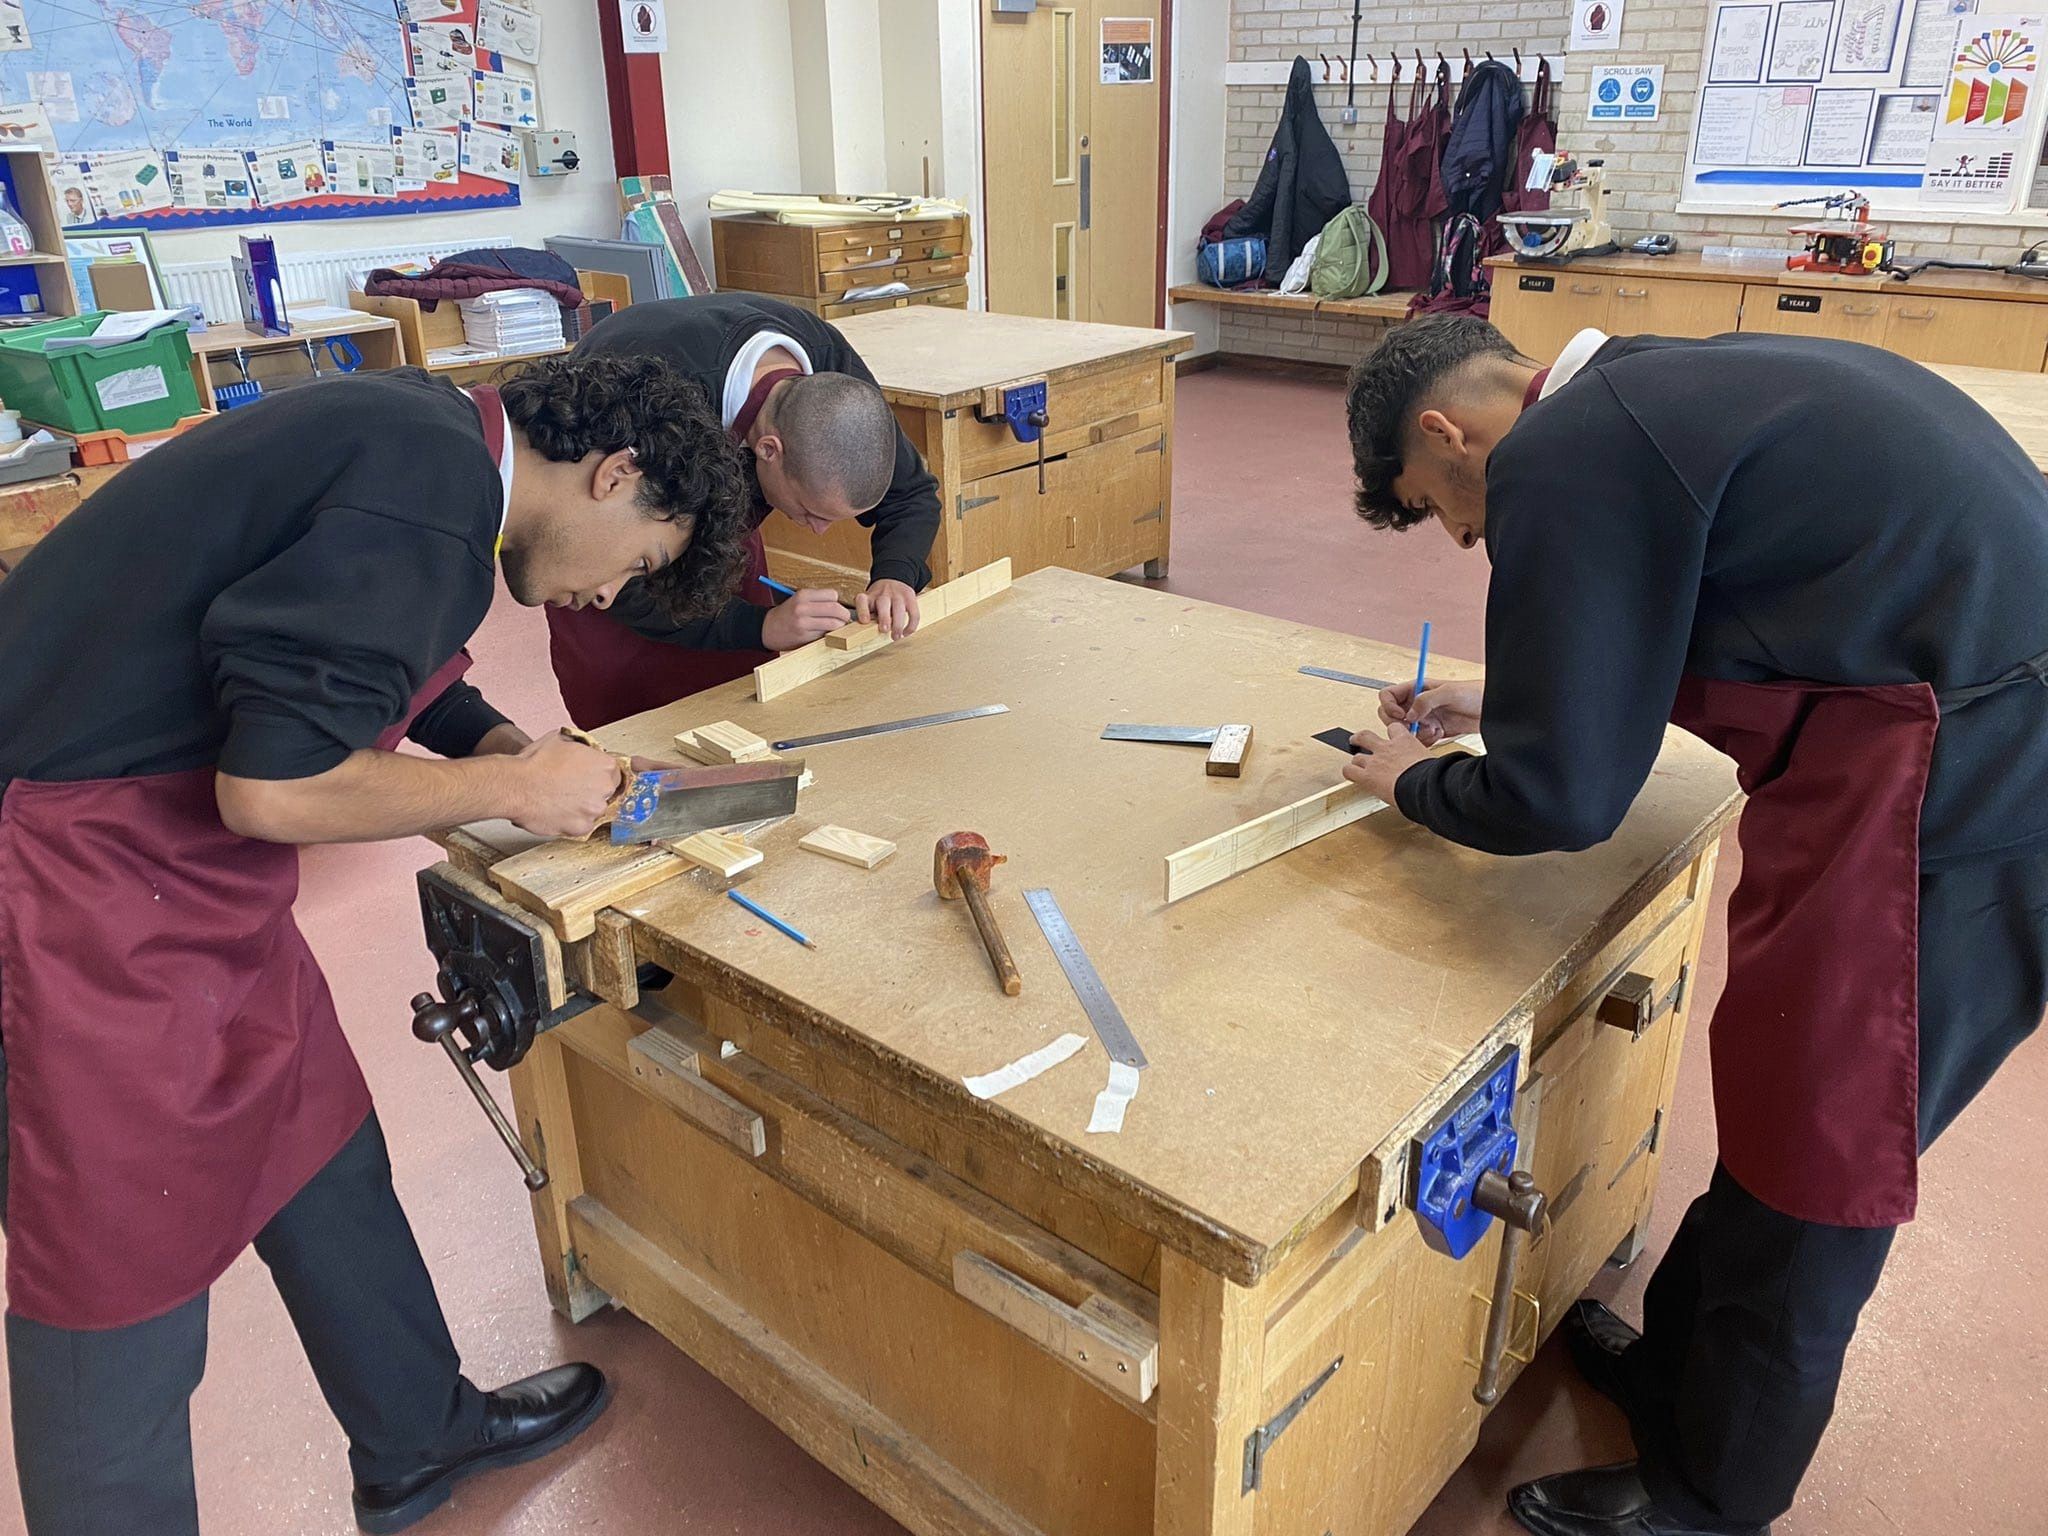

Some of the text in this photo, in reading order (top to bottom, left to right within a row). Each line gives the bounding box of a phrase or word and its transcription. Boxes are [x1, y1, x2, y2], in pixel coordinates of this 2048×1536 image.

[1604, 68, 1632, 76] SCROLL
[207, 118, 253, 128] The World
[1930, 179, 2004, 189] SAY IT BETTER
